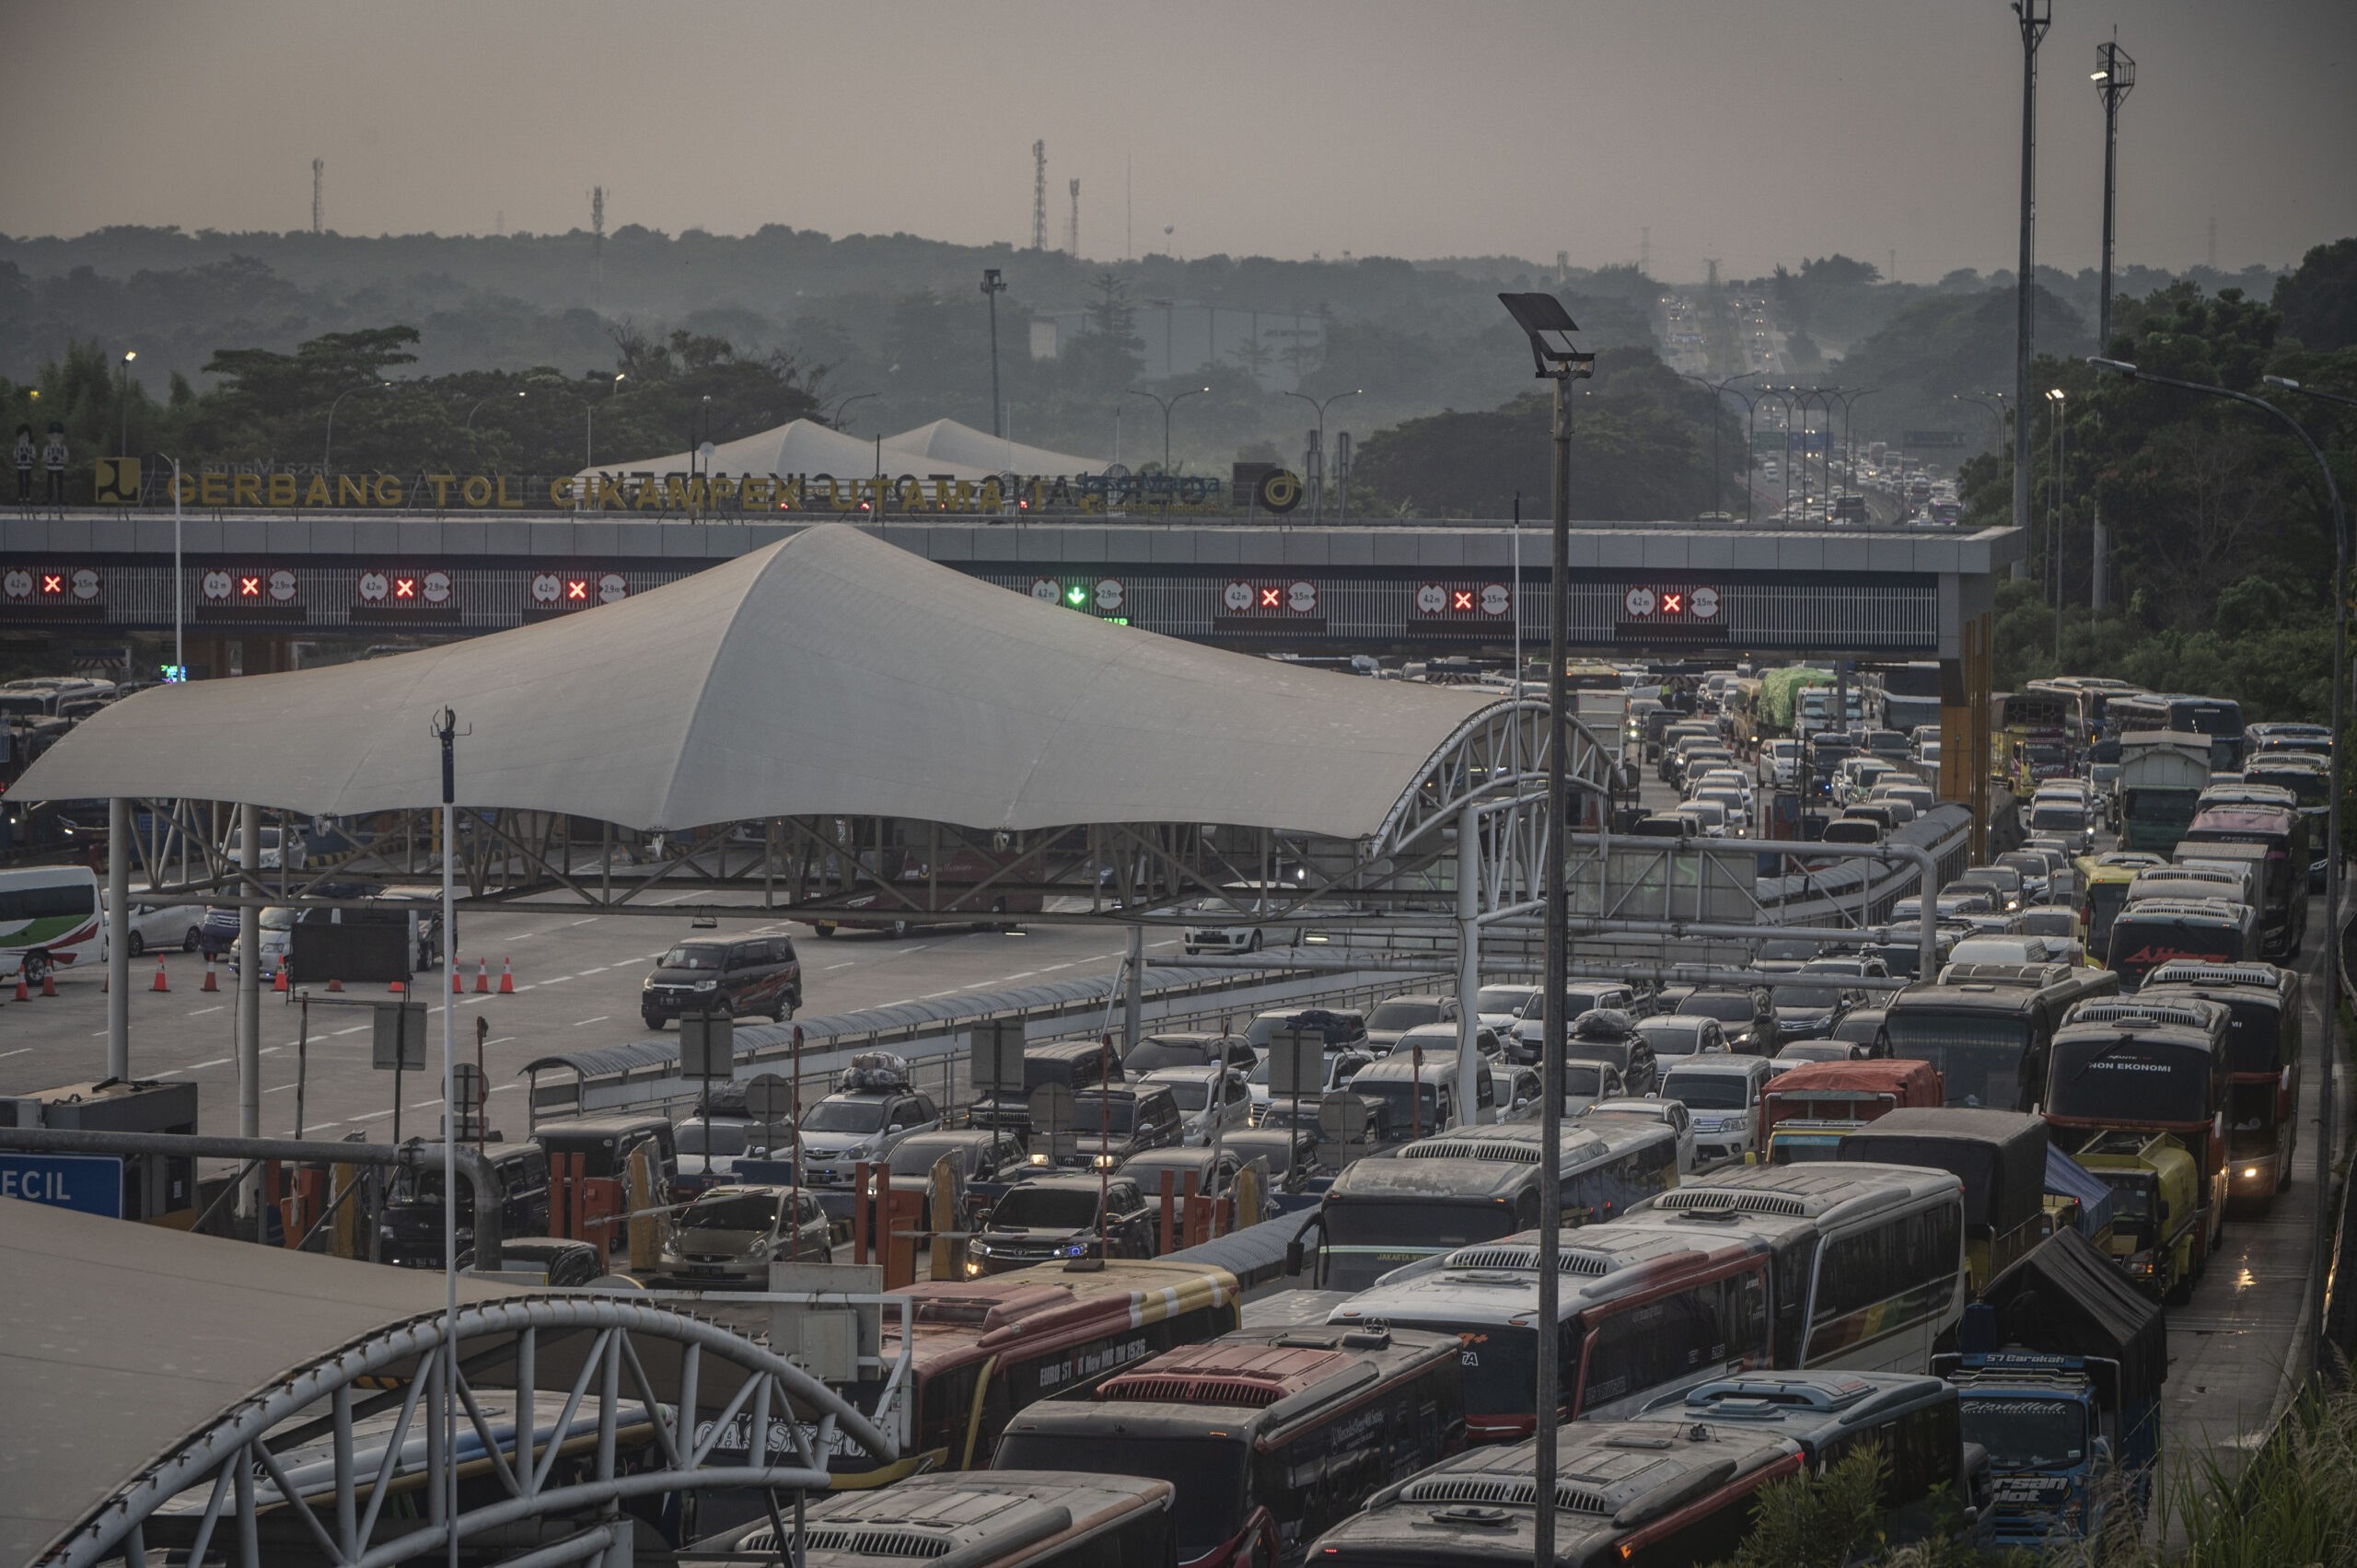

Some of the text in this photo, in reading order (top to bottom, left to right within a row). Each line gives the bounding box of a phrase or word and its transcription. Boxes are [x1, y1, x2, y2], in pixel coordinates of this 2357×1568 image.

[168, 473, 402, 505] GERBANG
[428, 475, 524, 506] TOL
[551, 475, 804, 511] CIKAMPEK
[830, 478, 1004, 512] UTAMA
[1081, 470, 1220, 497] Jasa Marga
[2118, 1063, 2172, 1072] EKONOMI
[2, 1170, 71, 1200] ECIL
[1039, 1365, 1061, 1388] EURO
[1085, 1353, 1100, 1375] New
[1101, 1347, 1115, 1369] MB
[1991, 1478, 2069, 1491] rsan
